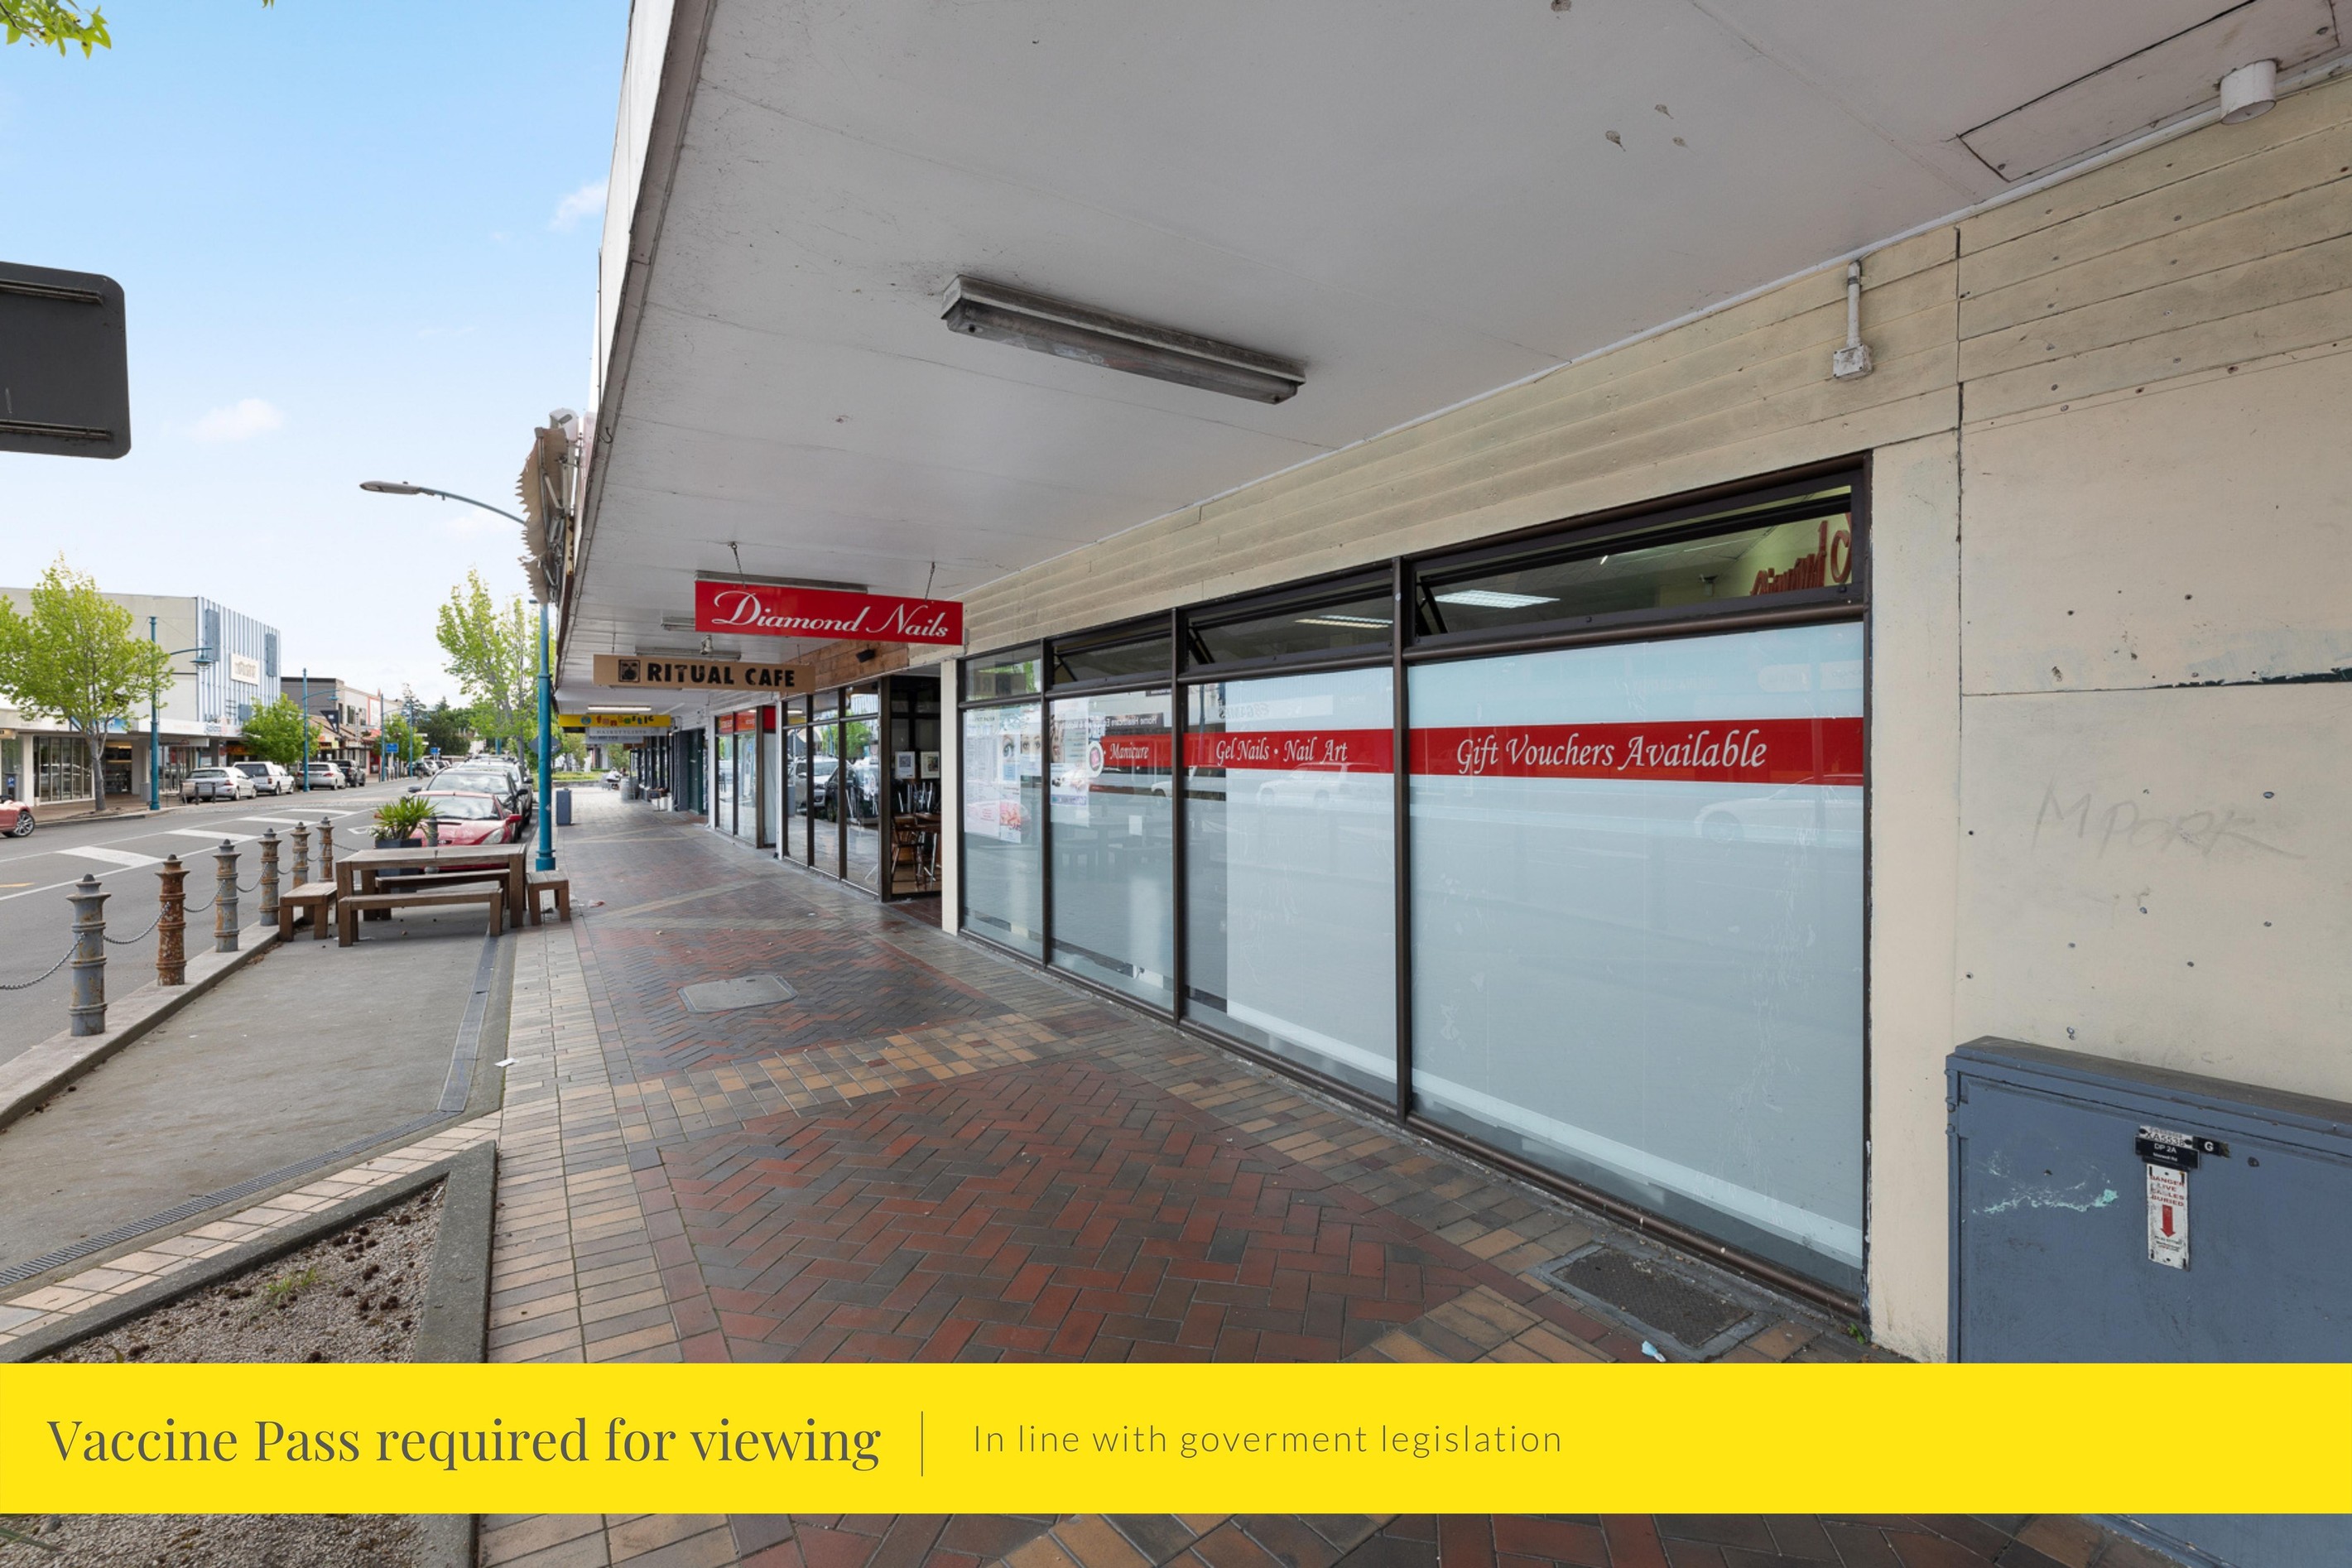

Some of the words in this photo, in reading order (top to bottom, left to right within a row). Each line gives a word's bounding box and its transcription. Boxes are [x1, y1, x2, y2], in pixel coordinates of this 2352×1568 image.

[711, 590, 870, 632] Diamond
[866, 604, 949, 637] Nails
[647, 663, 734, 685] RITUAL
[745, 667, 795, 687] CAFE
[1109, 743, 1150, 760] Manicure
[1216, 736, 1238, 767] Gel
[1237, 737, 1270, 761] Nails
[1283, 736, 1317, 762] Nail
[1320, 738, 1348, 764] Art
[1456, 734, 1499, 775] Gift
[1505, 733, 1614, 767] Vouchers
[1618, 729, 1768, 771] Available
[2154, 1142, 2166, 1151] DP
[2166, 1145, 2177, 1153] 2A
[2204, 1141, 2214, 1152] G
[2150, 1176, 2185, 1187] DANGER
[2157, 1183, 2176, 1192] LIVE
[2151, 1188, 2185, 1200] CALES
[2151, 1194, 2184, 1206] BURIED
